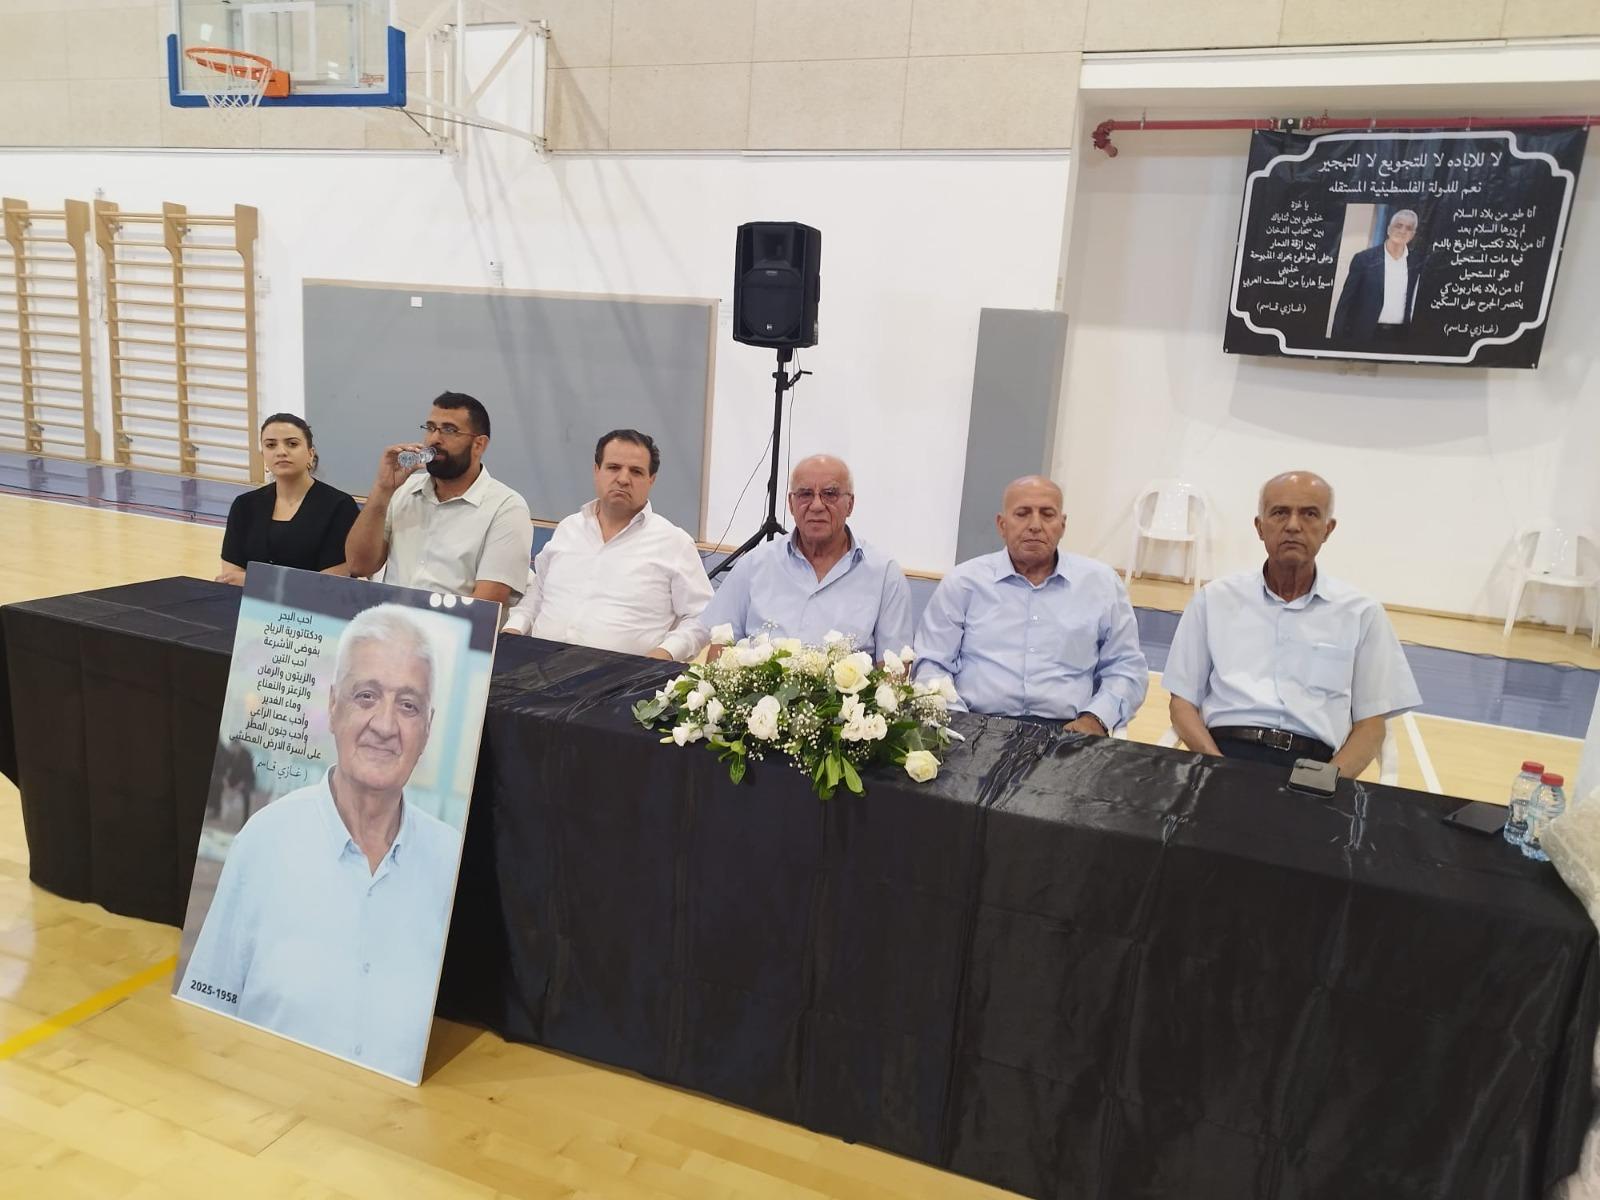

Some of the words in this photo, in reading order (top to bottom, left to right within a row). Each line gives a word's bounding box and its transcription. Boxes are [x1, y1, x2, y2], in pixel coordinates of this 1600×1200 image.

[1318, 154, 1360, 172] للتهجير
[1366, 154, 1377, 167] لا
[1378, 154, 1428, 176] للتجويع
[1433, 153, 1444, 167] لا
[1490, 152, 1502, 167] لا
[1370, 181, 1424, 197] الفلسطينية
[1428, 181, 1458, 197] للدولة
[1462, 182, 1482, 200] نعم
[1290, 200, 1302, 211] غزة
[1304, 200, 1310, 211] يا
[1527, 205, 1536, 218] أنا
[1454, 208, 1478, 222] السلام
[1480, 208, 1494, 220] بلاد
[1494, 212, 1508, 221] من
[1510, 208, 1524, 221] طير
[1312, 228, 1324, 238] بين
[1458, 226, 1472, 235] بعد
[1473, 224, 1498, 236] السلام
[1500, 224, 1518, 238] يزرها
[1520, 224, 1526, 238] لم
[1269, 239, 1290, 249] الدمار
[1304, 241, 1316, 250] بين
[1432, 238, 1452, 252] بالدم
[1452, 239, 1478, 253] التاريخ
[1480, 238, 1504, 251] تكتب
[1506, 239, 1519, 250] بلاد
[1520, 244, 1534, 252] من
[1536, 236, 1546, 248] أنا
[1317, 252, 1334, 264] وعلى
[1450, 254, 1488, 266] المستحيل
[1490, 254, 1508, 262] مات
[1510, 254, 1524, 266] فيها
[1459, 268, 1496, 280] المستحيل
[1484, 283, 1498, 295] بلاد
[1514, 281, 1524, 292] أنا
[1461, 298, 1476, 310] على
[1478, 298, 1500, 312] الجرح
[1500, 298, 1524, 311] ينتصر
[278, 612, 296, 622] البحر
[264, 622, 285, 635] الرياح
[272, 654, 290, 664] التين
[258, 664, 284, 680] والرمان
[285, 671, 316, 686] والزيتون
[256, 678, 286, 694] والنعناع
[286, 684, 312, 700] والزعتر
[262, 695, 284, 706] الغدير
[284, 700, 302, 712] وماء
[272, 709, 288, 722] عصا
[268, 726, 287, 738] جنون
[306, 748, 321, 760] على
[190, 980, 238, 1004] 2025-1958
